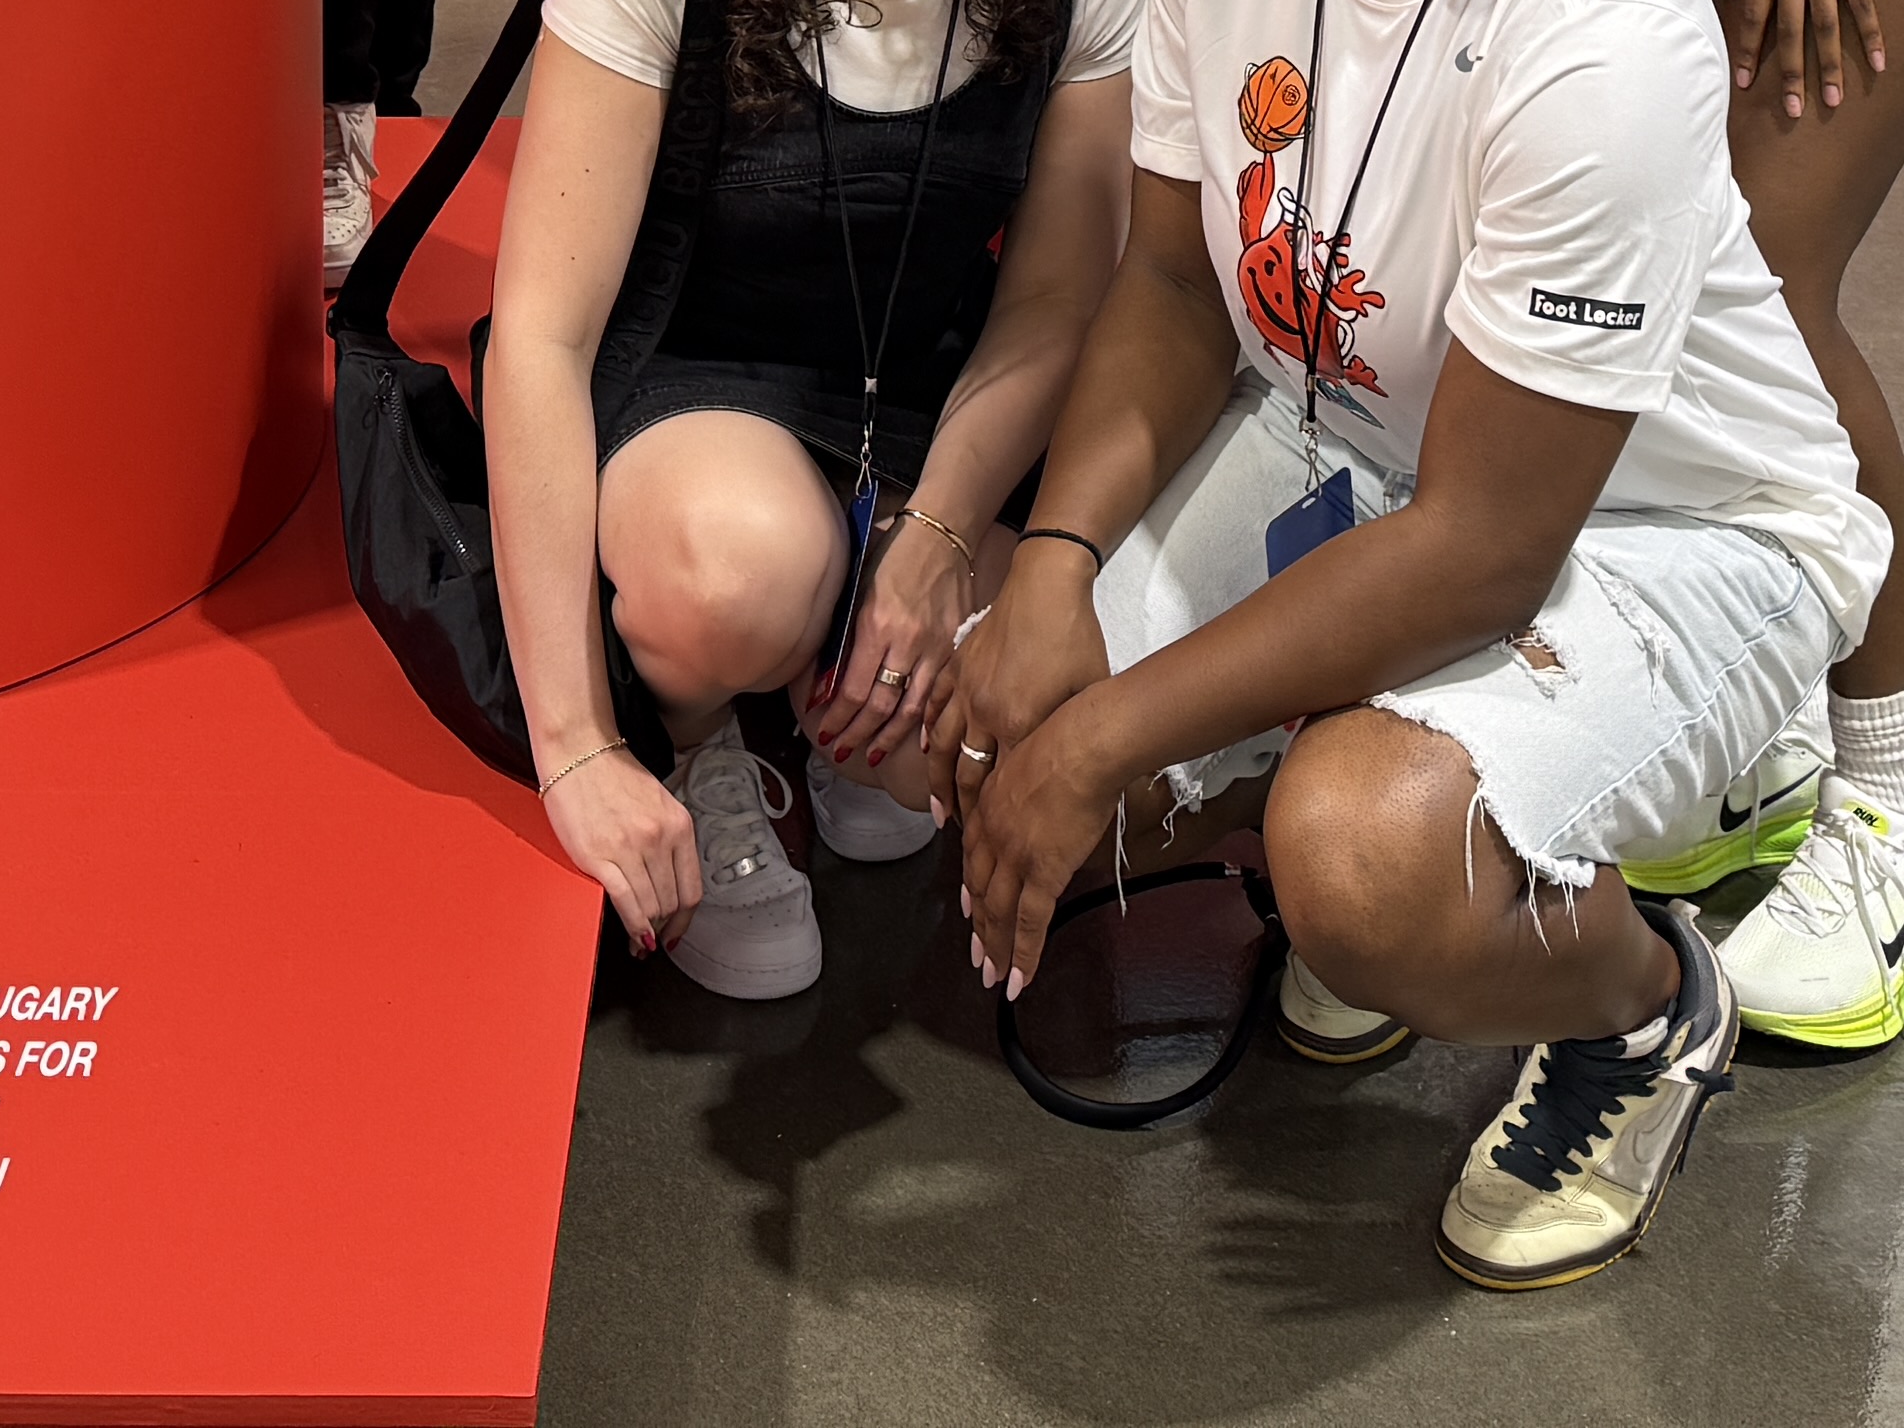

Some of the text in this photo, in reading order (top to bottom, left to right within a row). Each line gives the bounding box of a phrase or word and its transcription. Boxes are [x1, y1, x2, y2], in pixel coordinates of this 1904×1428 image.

[1533, 293, 1642, 326] Foot Locker
[15, 1040, 98, 1077] FOR
